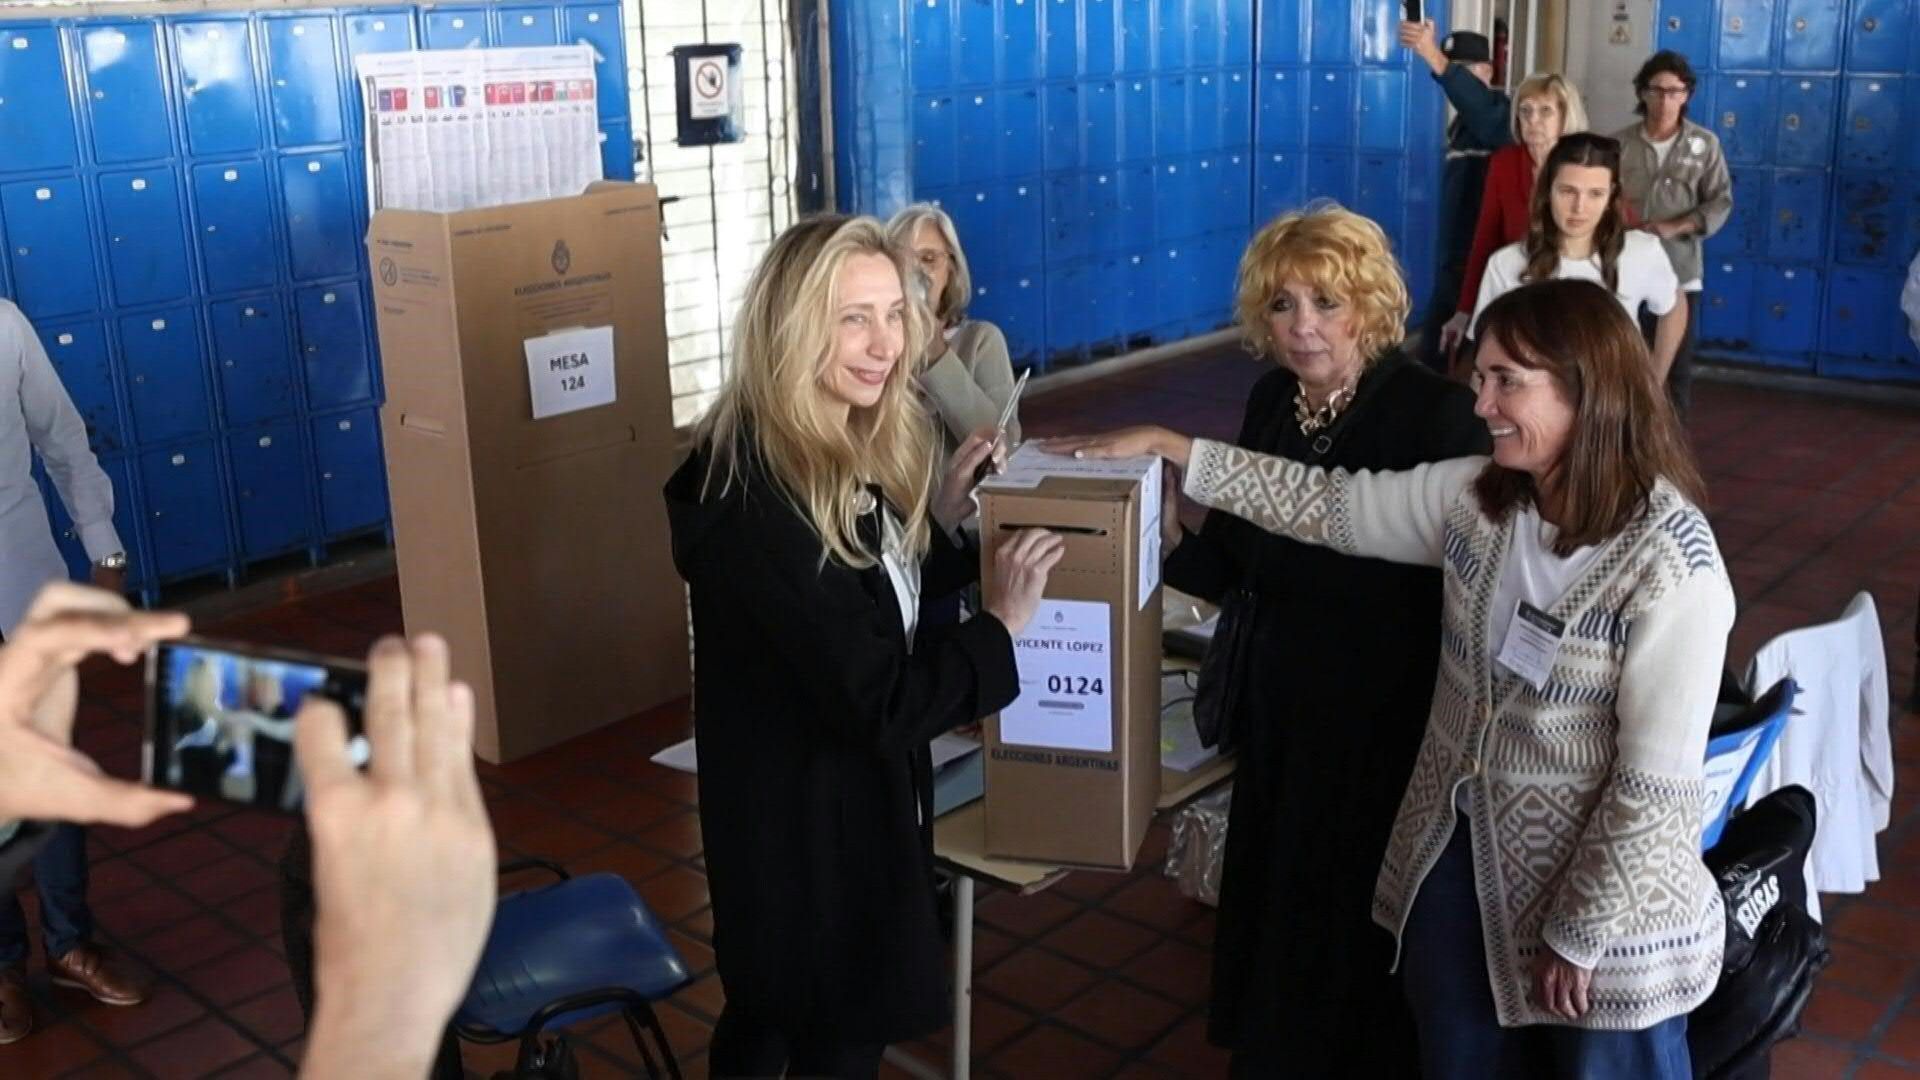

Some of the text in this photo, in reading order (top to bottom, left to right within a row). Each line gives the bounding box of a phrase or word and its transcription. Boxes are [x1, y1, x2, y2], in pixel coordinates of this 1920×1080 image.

[549, 352, 589, 372] MESA
[561, 377, 585, 392] 124
[1047, 674, 1104, 696] 0124
[991, 748, 1119, 772] ELECCIONES ARGENTINAS
